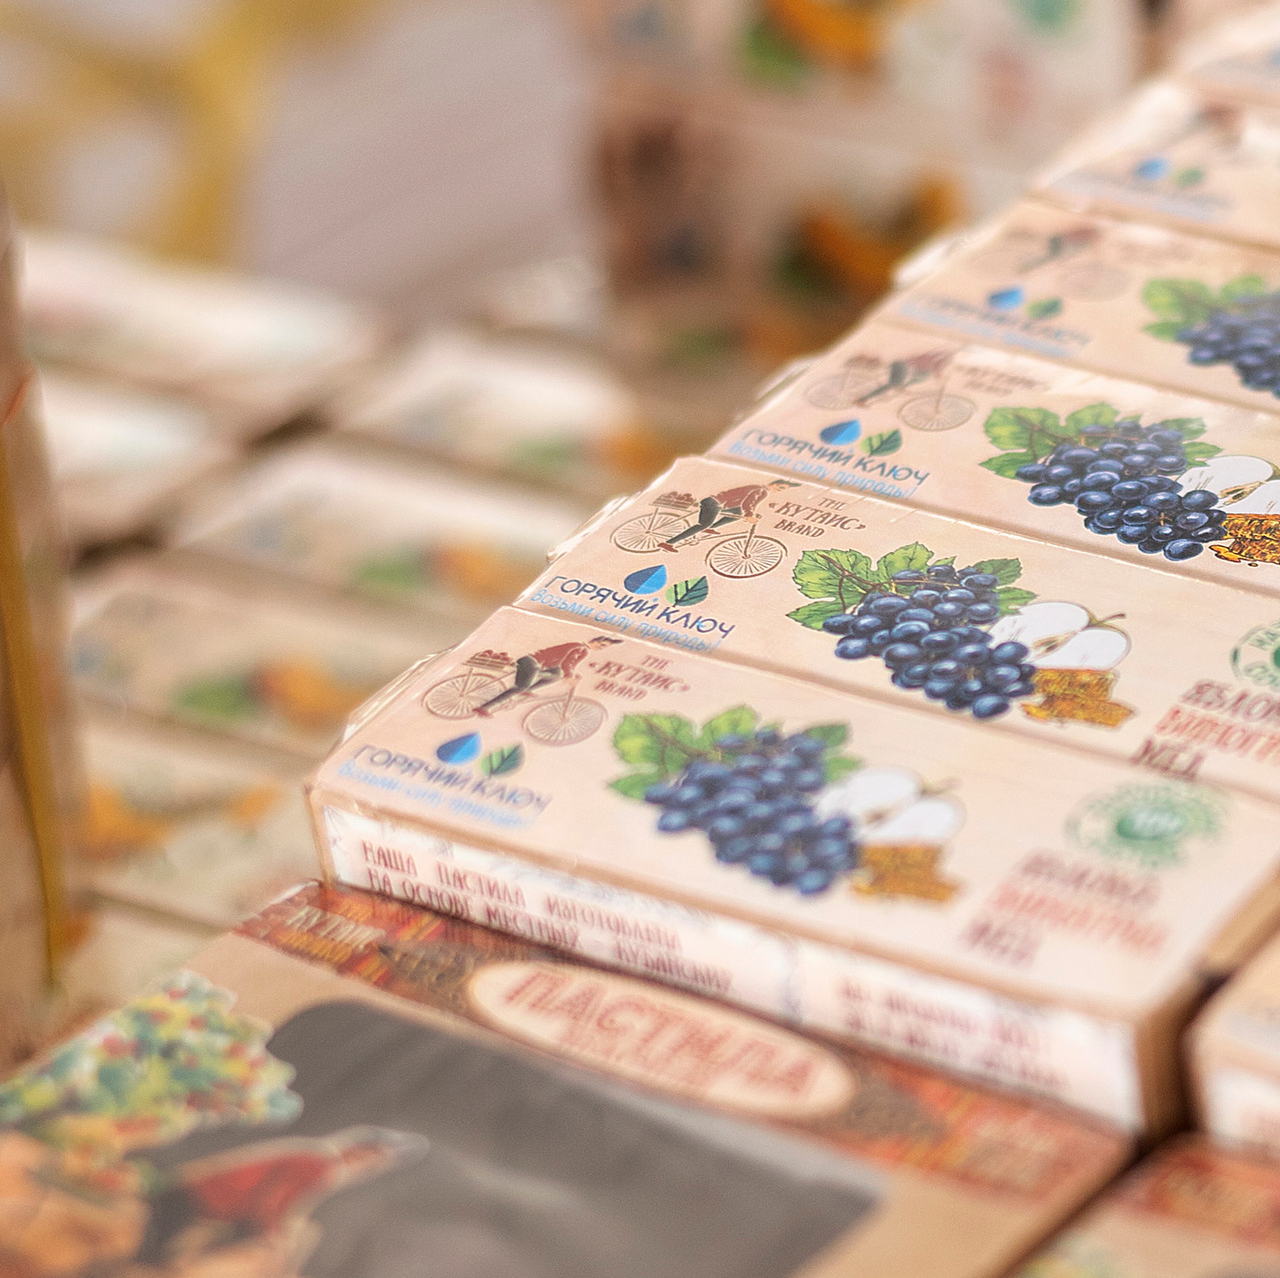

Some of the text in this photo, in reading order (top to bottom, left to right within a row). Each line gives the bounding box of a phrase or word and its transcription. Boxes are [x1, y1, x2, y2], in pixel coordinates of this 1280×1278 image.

[742, 428, 931, 486] ГОРЯЧИЙ КЛЮЧ
[773, 519, 826, 538] BRAND
[818, 496, 846, 511] THE
[530, 588, 723, 655] Возьми силу природы!
[545, 575, 736, 640] ГОРЯЧИЙ КЛЮЧ
[361, 840, 418, 877] НАША
[436, 860, 527, 908] ПАСТИЛА
[367, 868, 395, 897] НА
[402, 880, 475, 919] ОСНОВЕ
